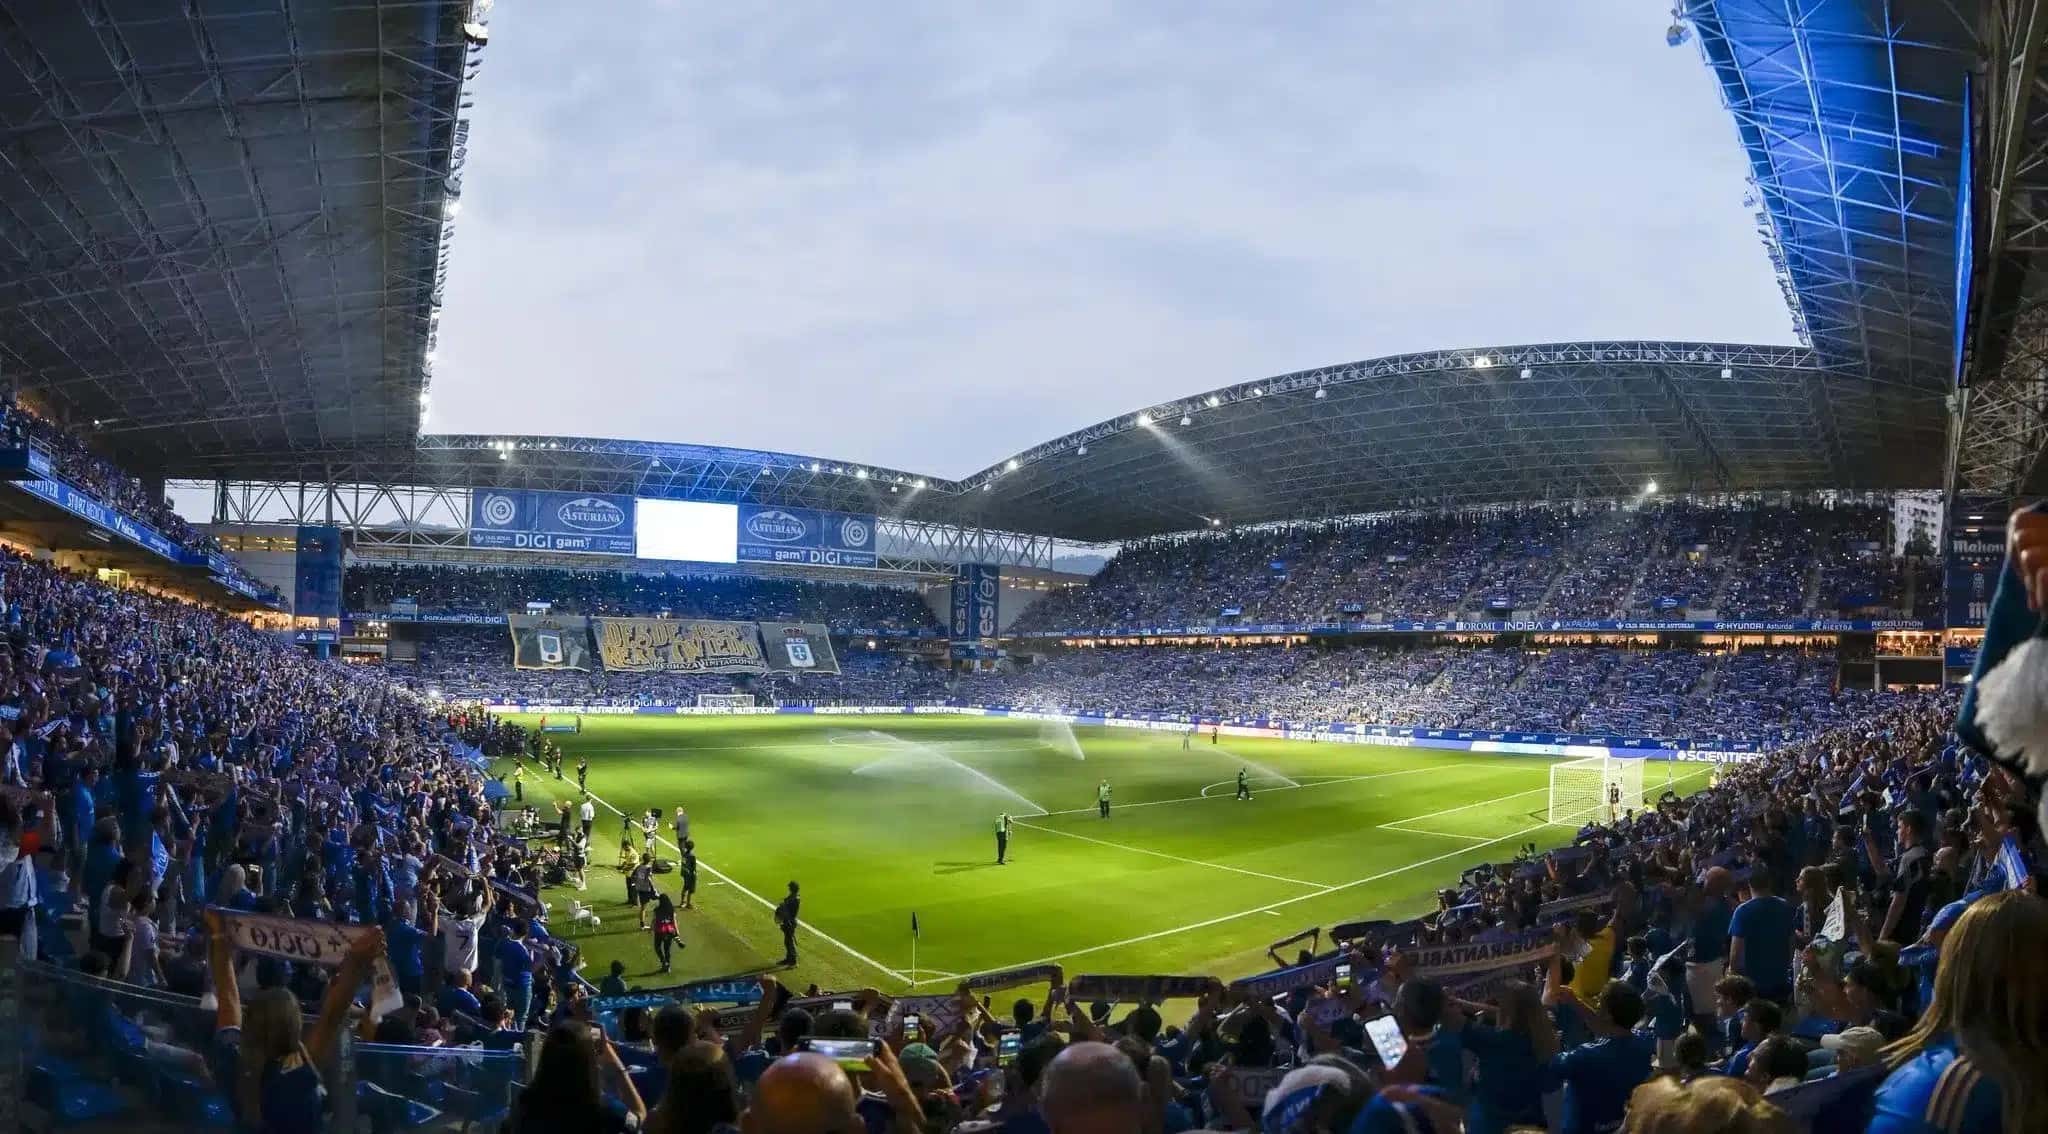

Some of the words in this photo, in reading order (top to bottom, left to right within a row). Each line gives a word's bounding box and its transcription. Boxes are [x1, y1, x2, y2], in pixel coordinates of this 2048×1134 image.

[563, 507, 621, 523] ASTURIANA
[751, 520, 801, 535] ASTURIANA
[515, 533, 551, 548] DIGI
[775, 550, 800, 562] gam
[810, 550, 840, 564] DIGI
[485, 616, 502, 624] DIGI
[1504, 621, 1543, 631] INDIBA
[1726, 622, 1764, 630] HYUNDAI
[1871, 619, 1923, 627] RESOLUTION
[634, 699, 653, 707] DIGI
[456, 928, 472, 950] 7
